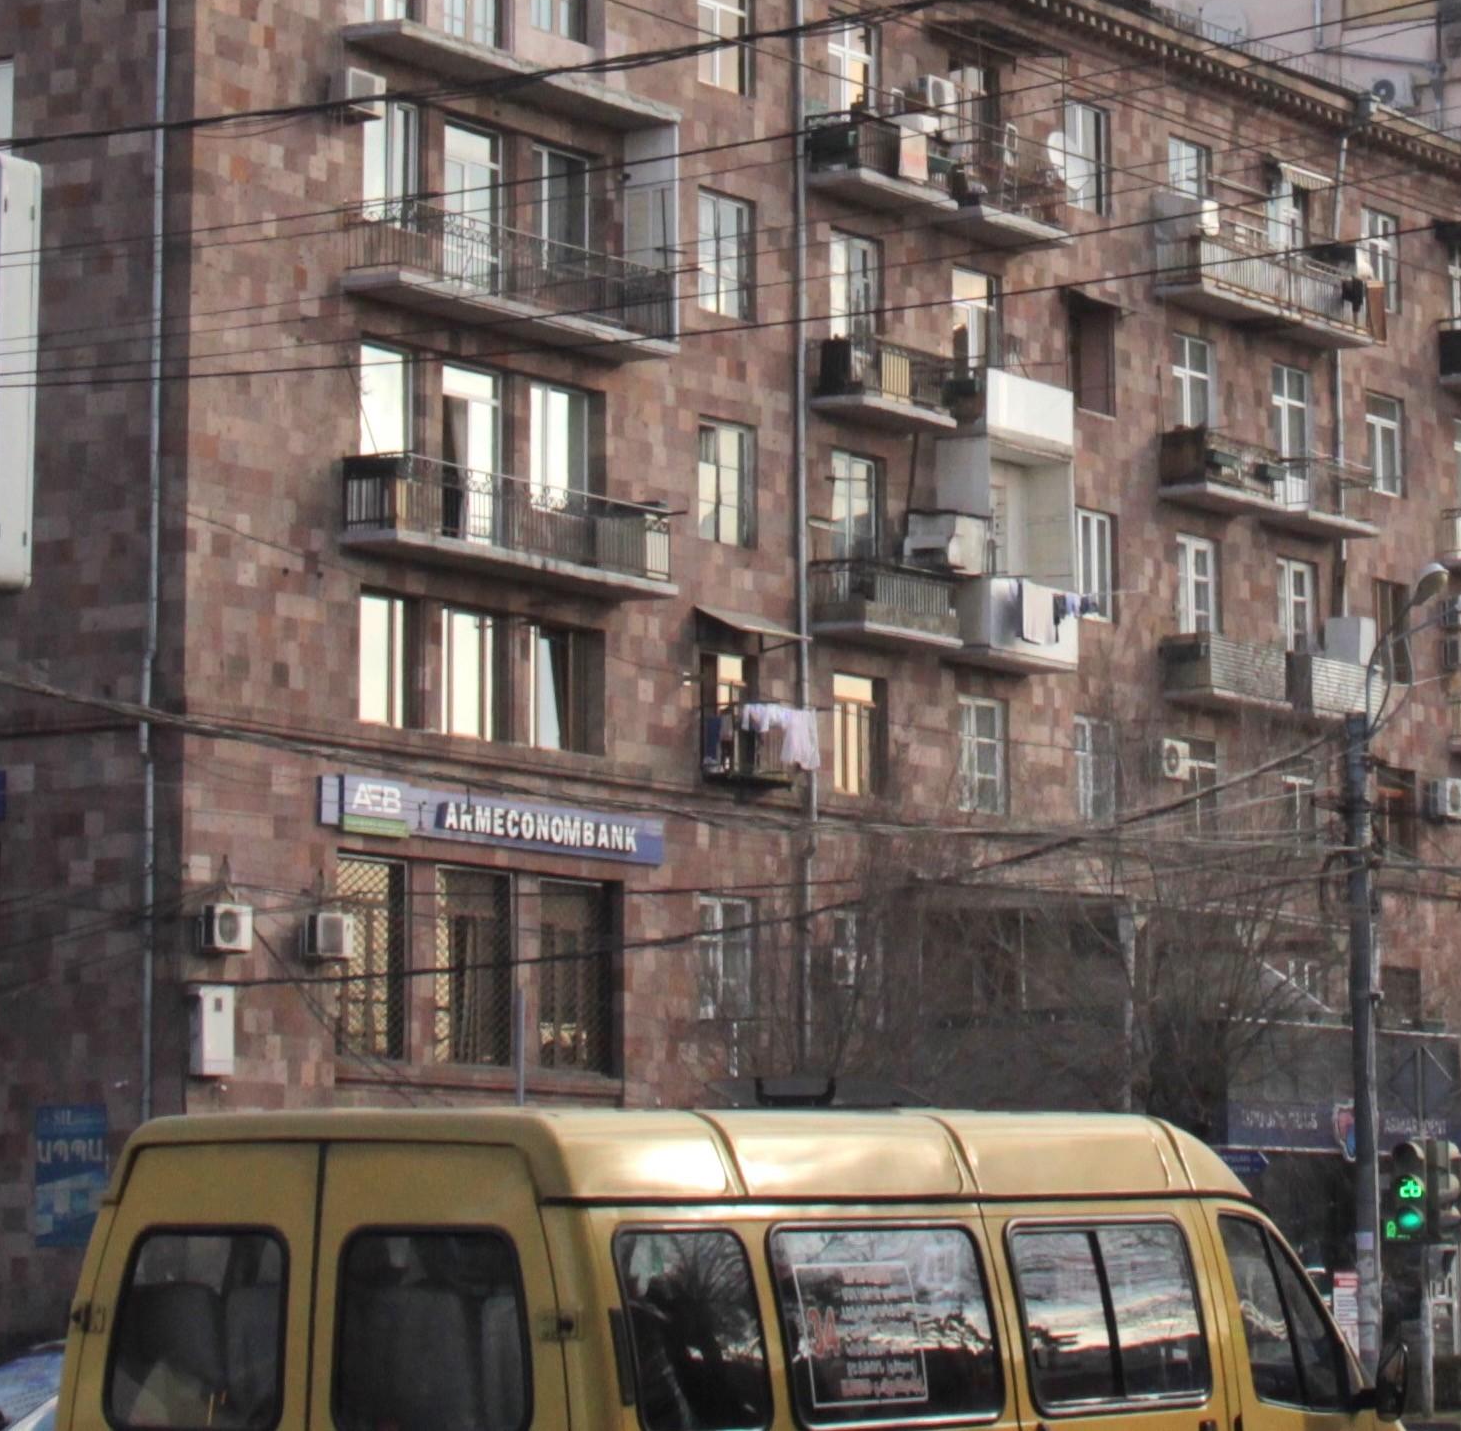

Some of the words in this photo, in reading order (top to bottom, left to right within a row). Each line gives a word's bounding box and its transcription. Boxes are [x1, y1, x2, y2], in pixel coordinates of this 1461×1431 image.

[352, 782, 402, 815] AEB
[444, 801, 638, 853] ARMECONOMBANK
[1399, 1178, 1424, 1199] 26
[806, 1305, 841, 1359] 34
